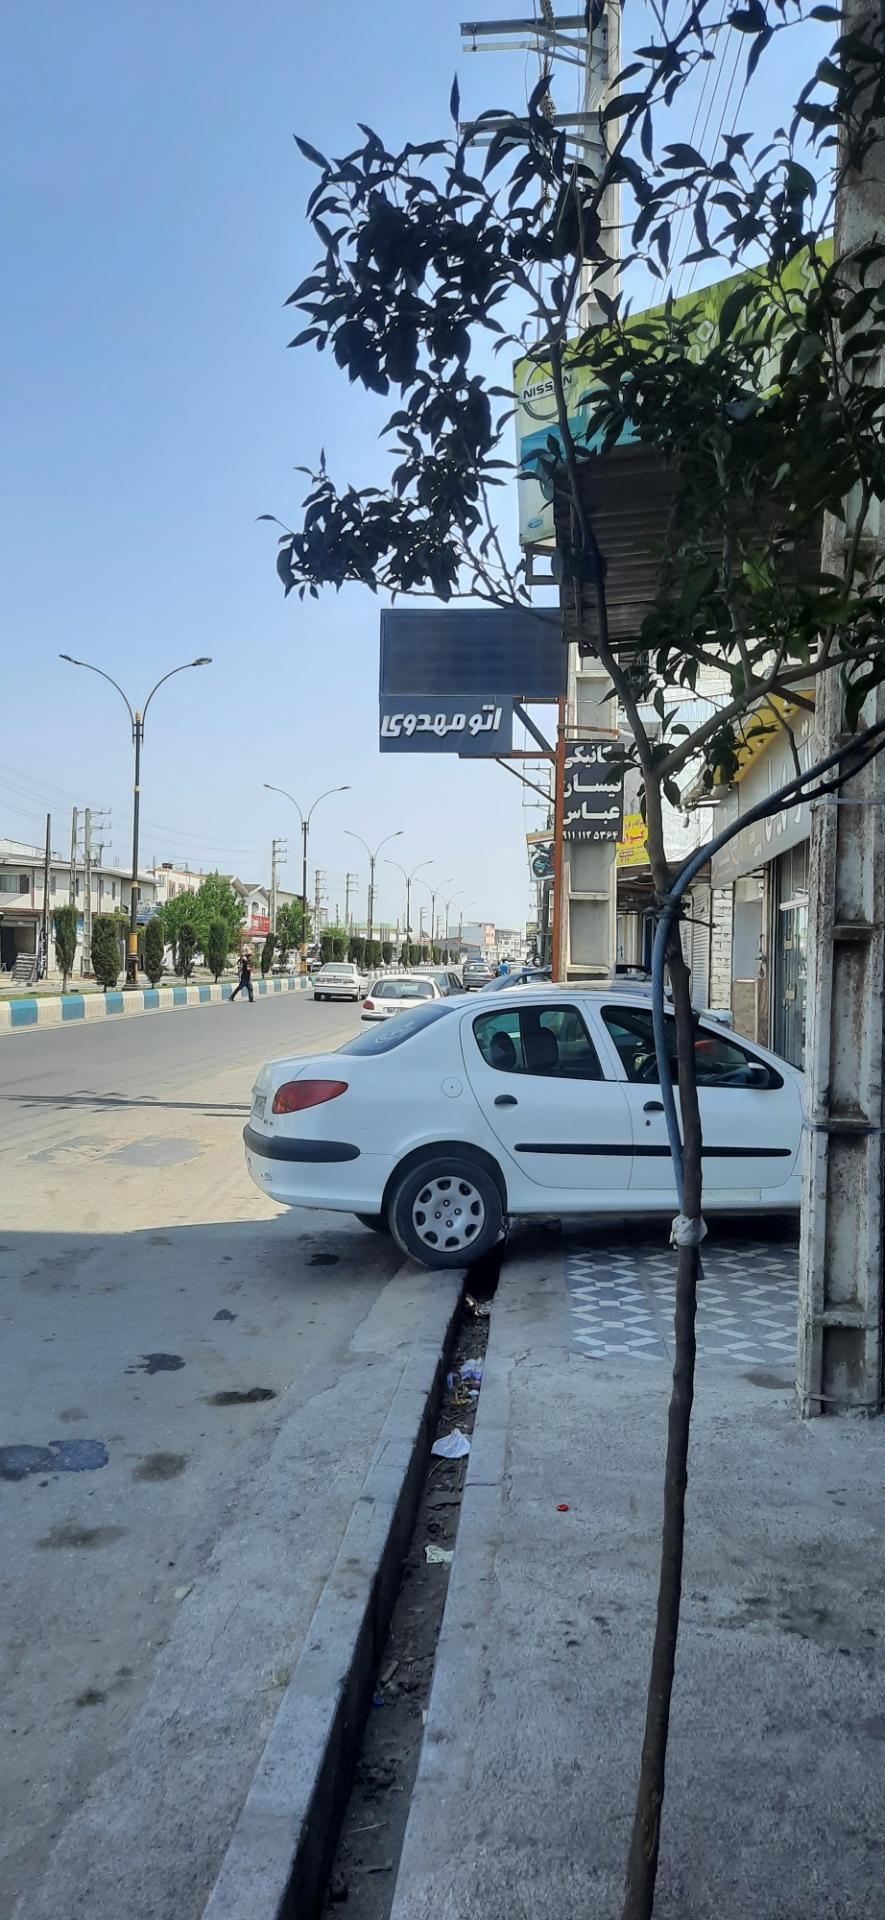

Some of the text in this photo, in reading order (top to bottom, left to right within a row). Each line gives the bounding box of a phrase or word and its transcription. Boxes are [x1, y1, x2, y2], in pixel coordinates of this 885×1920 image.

[524, 374, 572, 399] NISSN
[380, 704, 503, 737] اتو مهدوی
[563, 744, 620, 768] کانیکی
[562, 801, 620, 825] عباس
